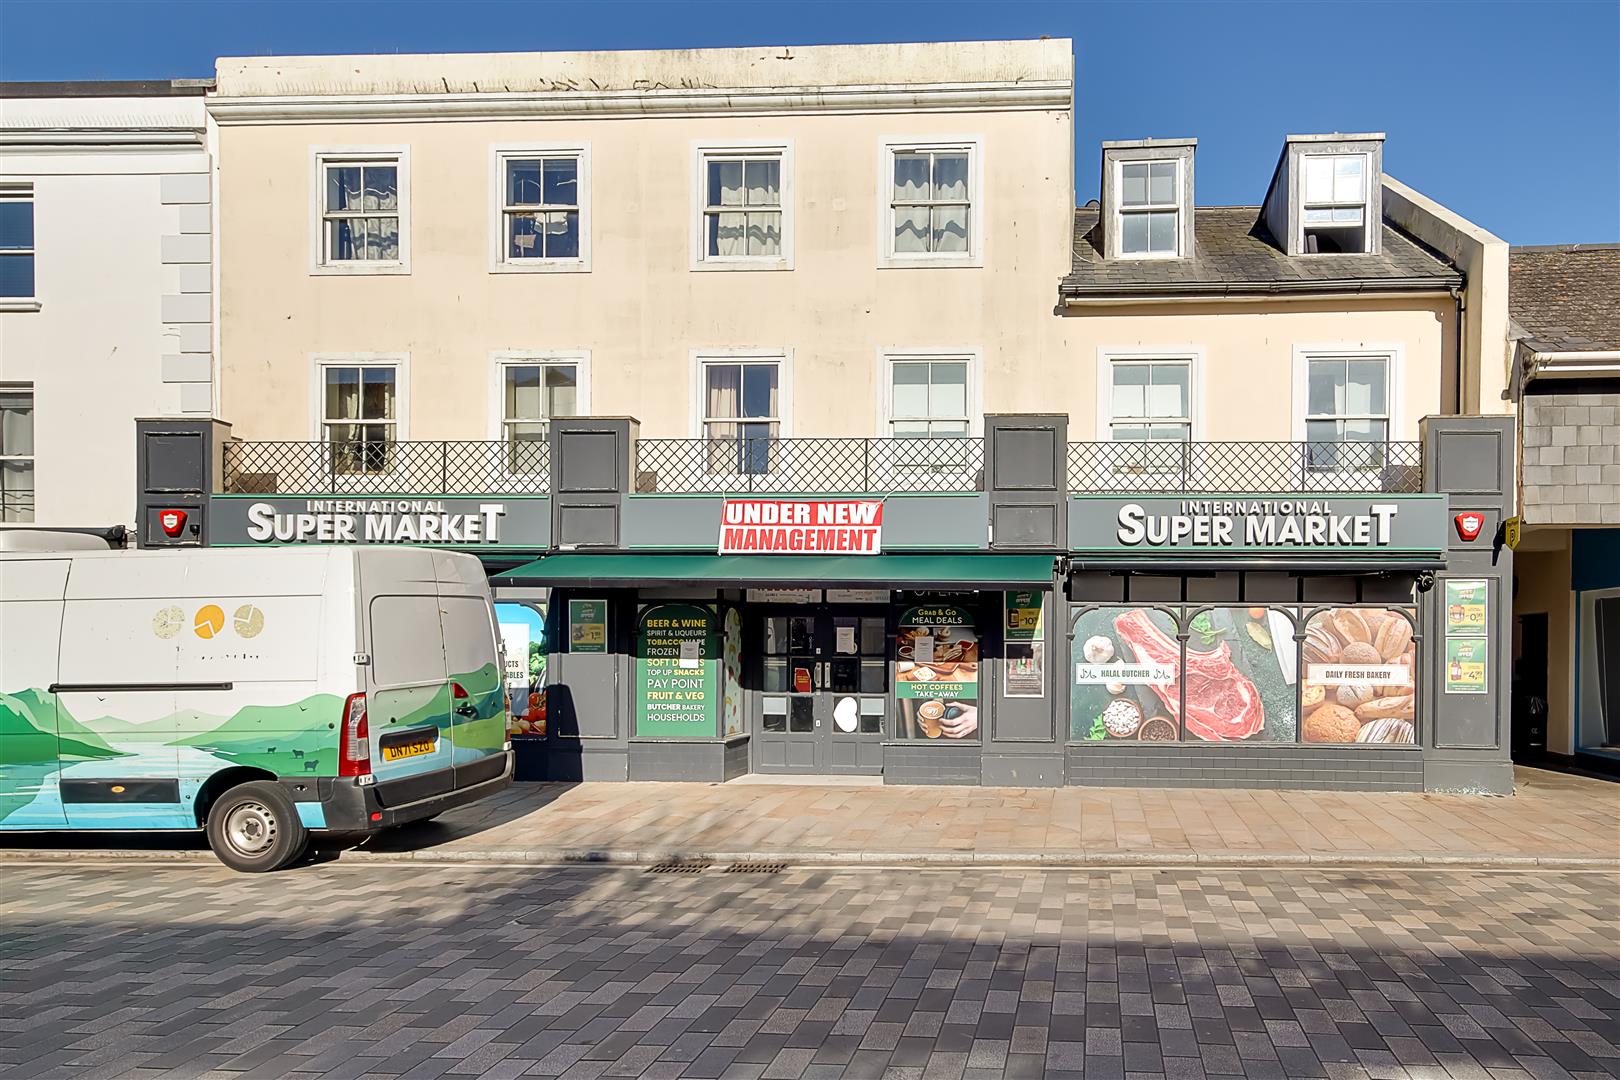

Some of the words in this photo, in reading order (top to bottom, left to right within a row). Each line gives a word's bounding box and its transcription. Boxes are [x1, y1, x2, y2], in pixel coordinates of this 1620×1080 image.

[306, 500, 446, 514] INTERNATIONAL
[1180, 500, 1333, 515] INTERNATIONAL
[726, 502, 811, 524] UNDER
[817, 502, 880, 525] NEW
[246, 502, 358, 542] SUPER
[364, 503, 506, 542] MARKET
[1117, 503, 1234, 544] SUPER
[1245, 503, 1399, 544] MARKET
[723, 528, 877, 551] MANAGEMENT
[918, 608, 937, 616] GRAB
[647, 619, 670, 628] BEER
[672, 619, 680, 628] &
[682, 619, 707, 628] WINE
[912, 616, 935, 624] MEAL
[936, 616, 963, 624] DEALS
[647, 629, 666, 637] SPIRIT
[668, 629, 673, 637] &
[675, 629, 707, 637] LIQUEURS
[647, 638, 684, 646] TOBACCO
[647, 647, 679, 656] FROZEN
[647, 658, 669, 667] SOFT
[1101, 669, 1120, 678] HALAL
[1122, 669, 1150, 678] BUTCHER
[1326, 670, 1343, 679] DAILY
[1345, 671, 1365, 679] FRESH
[1367, 671, 1391, 679] BAKERY
[647, 679, 669, 689] PAY
[671, 679, 705, 689] POINT
[647, 691, 674, 700] FRUIT
[675, 691, 683, 700] &
[685, 691, 705, 700] VEG
[647, 713, 705, 722] HOUSEHOLDS
